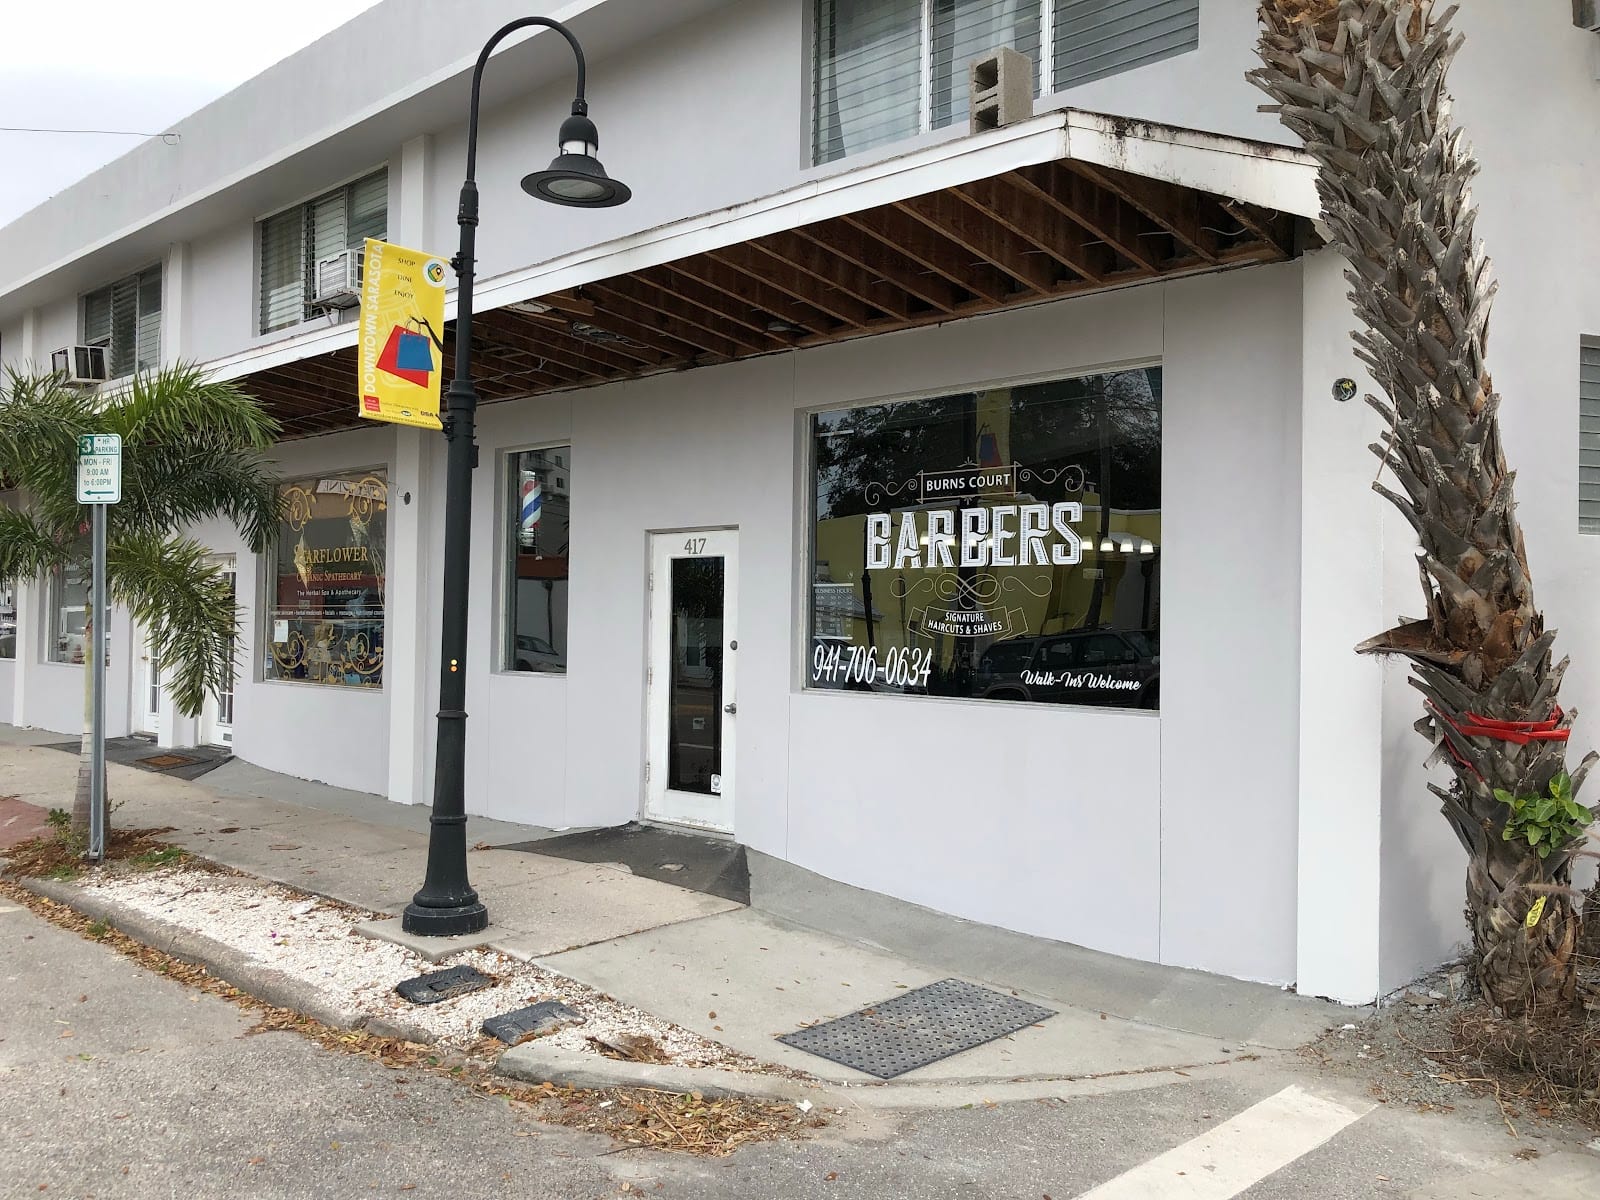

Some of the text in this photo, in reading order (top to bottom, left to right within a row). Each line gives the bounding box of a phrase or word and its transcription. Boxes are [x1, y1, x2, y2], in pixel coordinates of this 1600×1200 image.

[398, 257, 416, 267] SHOP
[367, 244, 384, 311] SARASOTA
[394, 289, 414, 299] ENJOY
[364, 314, 378, 393] DOWNTOWN
[81, 438, 92, 453] 3
[83, 458, 98, 466] MON
[103, 458, 112, 466] FRI
[100, 468, 109, 476] AM
[926, 473, 1011, 492] BURNS COURT
[865, 501, 1083, 570] BARBERS
[684, 537, 707, 554] 417
[945, 612, 985, 623] SIGNATURE
[927, 619, 1003, 635] HAIRCUTS & SHAVES
[813, 644, 933, 687] 941-706-0634
[1020, 669, 1142, 690] Walk-Ins Welcome
